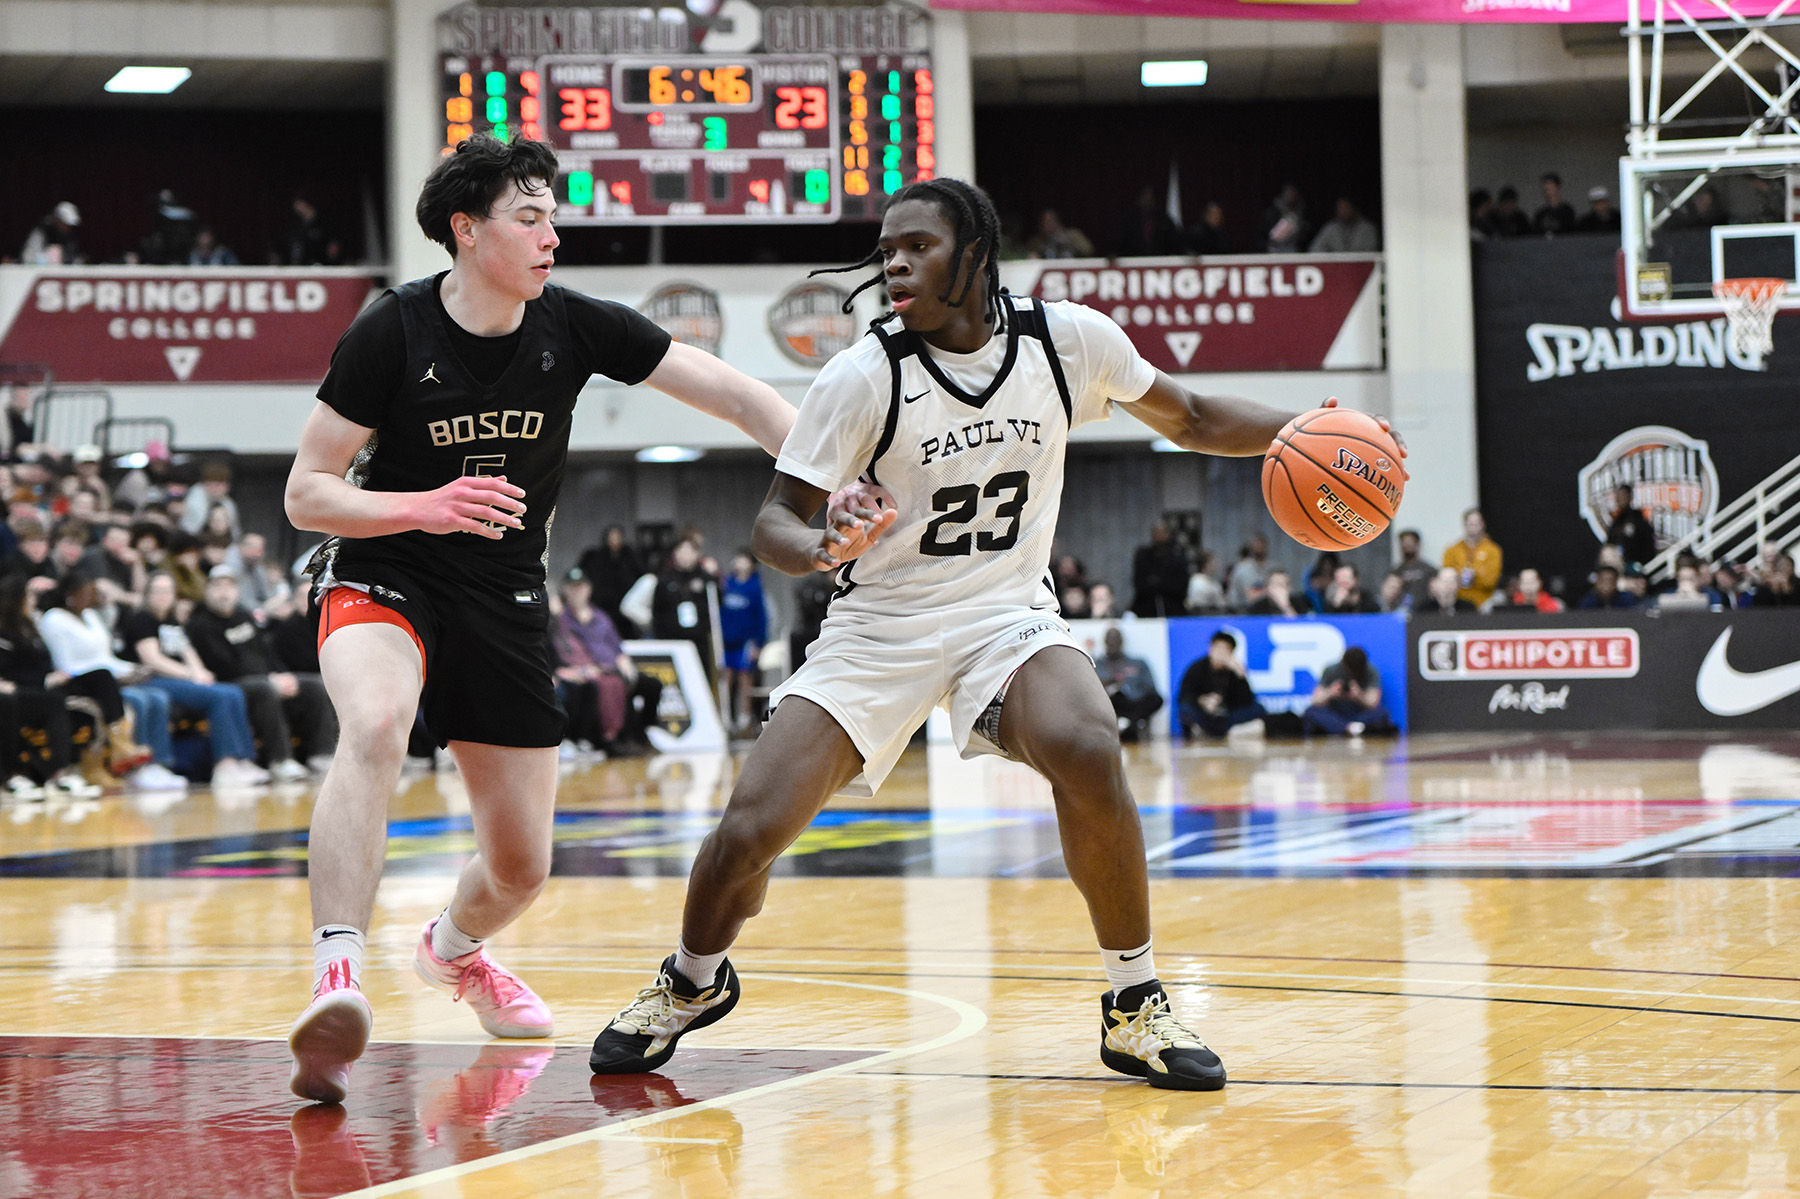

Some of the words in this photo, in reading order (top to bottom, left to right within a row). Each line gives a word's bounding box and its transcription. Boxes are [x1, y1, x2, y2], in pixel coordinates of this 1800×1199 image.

[453, 8, 687, 54] SPRINGFIELD
[765, 7, 912, 53] COLLEGE
[649, 65, 751, 105] 6:46
[559, 88, 612, 130] 33
[775, 87, 828, 129] 23
[703, 116, 727, 152] 3
[36, 280, 328, 313] SPRINGFIELD
[1041, 265, 1325, 301] SPRINGFIELD
[107, 316, 256, 340] COLLEGE
[1110, 302, 1255, 327] COLLEGE
[427, 410, 545, 446] BOSCO
[921, 419, 1004, 466] PAUL
[1007, 418, 1041, 445] VI
[1331, 446, 1402, 512] SPALDING
[919, 470, 1030, 556] 23
[1316, 482, 1379, 535] PRECISION
[1468, 639, 1627, 669] CHIPOTLE
